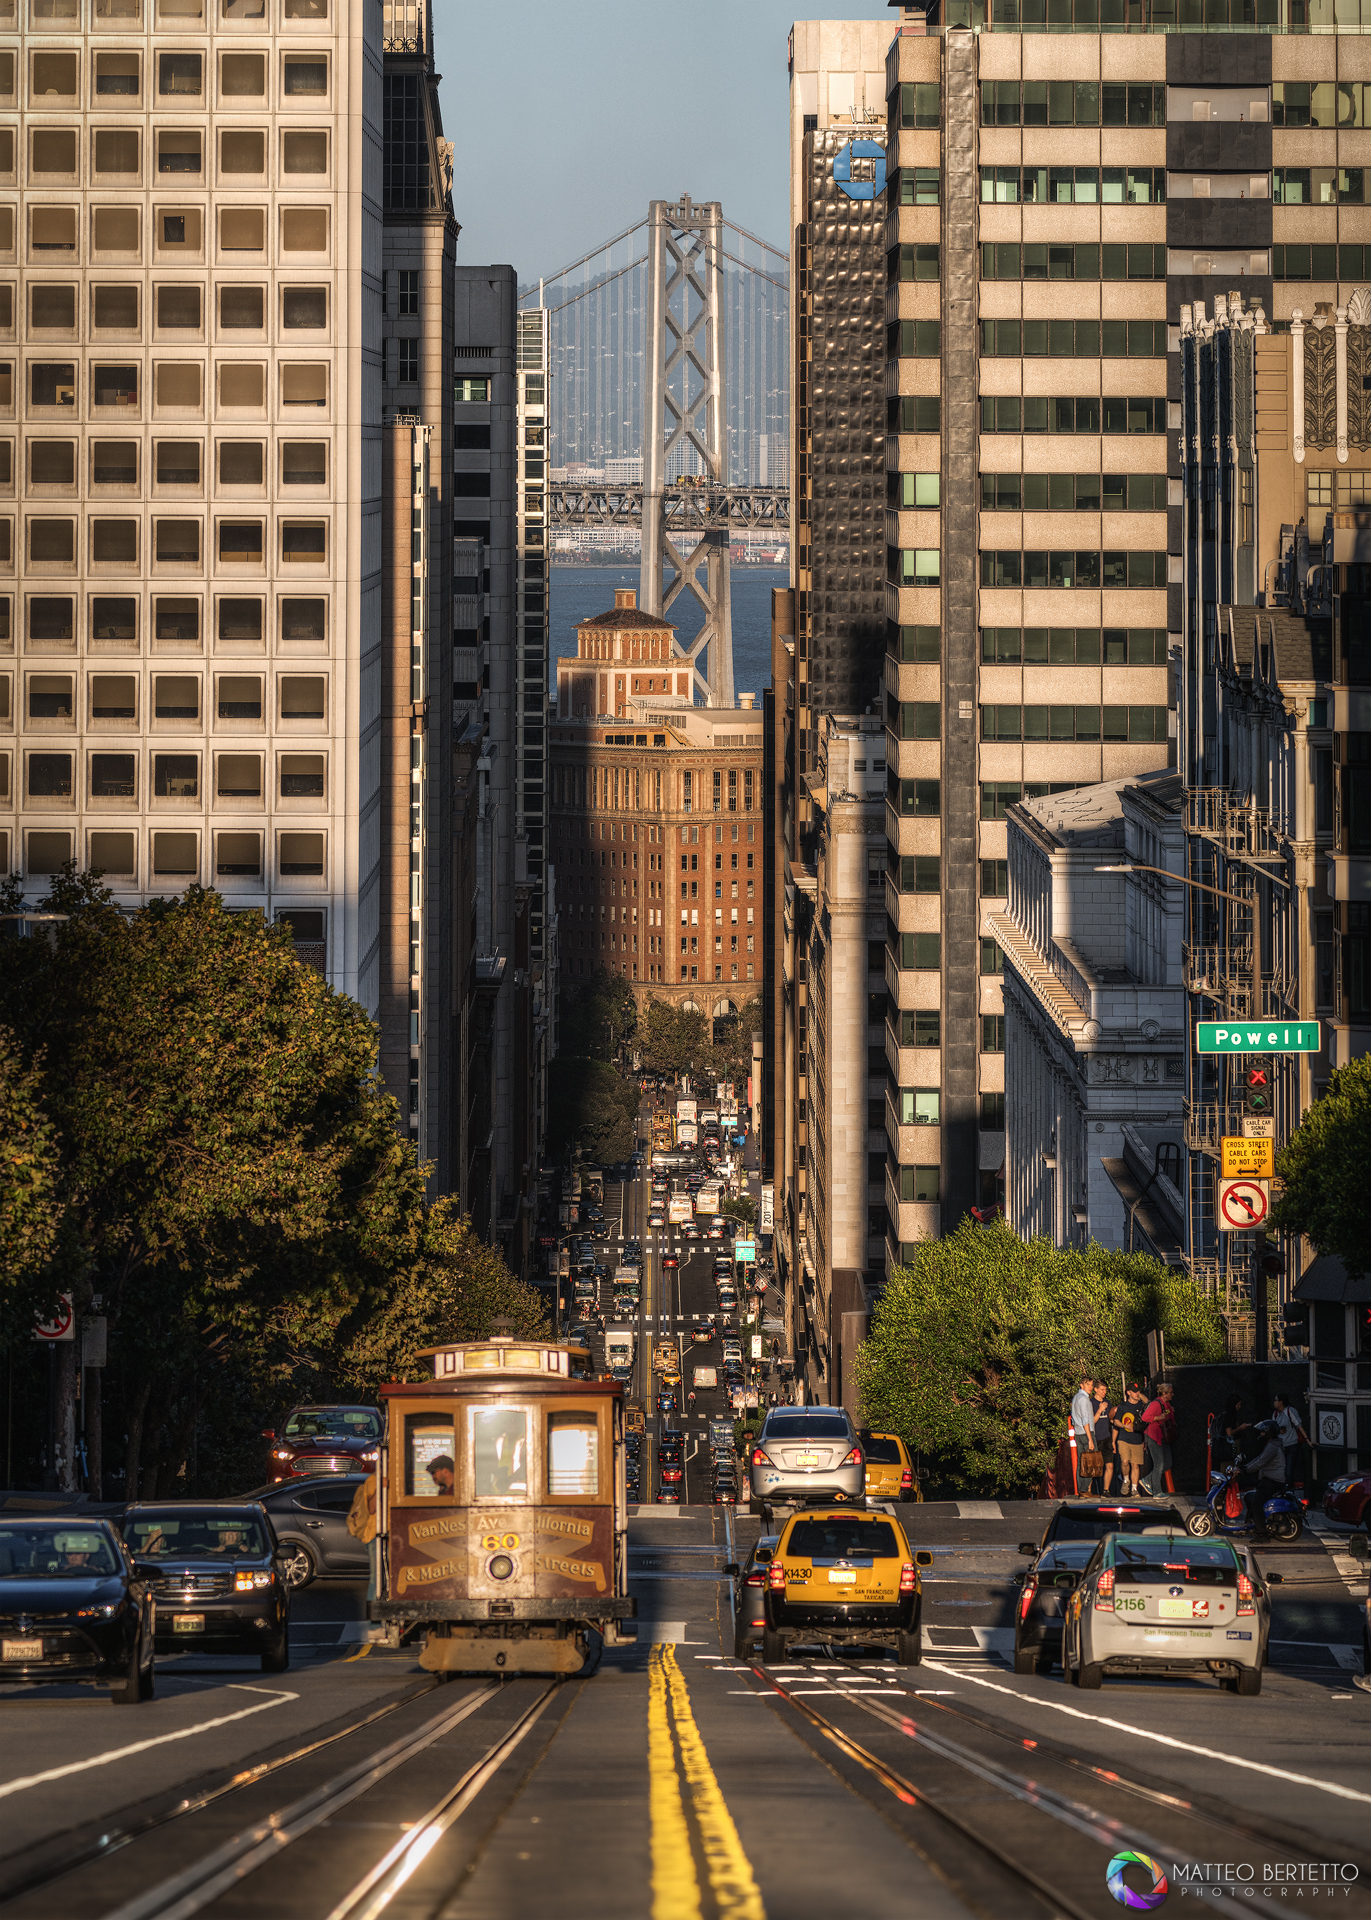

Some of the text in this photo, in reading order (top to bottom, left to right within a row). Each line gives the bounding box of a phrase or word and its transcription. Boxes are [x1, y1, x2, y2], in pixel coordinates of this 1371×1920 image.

[1215, 1029, 1302, 1045] Powell
[412, 1525, 438, 1539] Van
[438, 1520, 467, 1535] Nes
[537, 1515, 590, 1537] lifornia
[482, 1533, 519, 1551] 60
[406, 1568, 417, 1582] &
[419, 1560, 467, 1582] Marke
[784, 1568, 812, 1578] K1430
[1116, 1598, 1146, 1611] 2156
